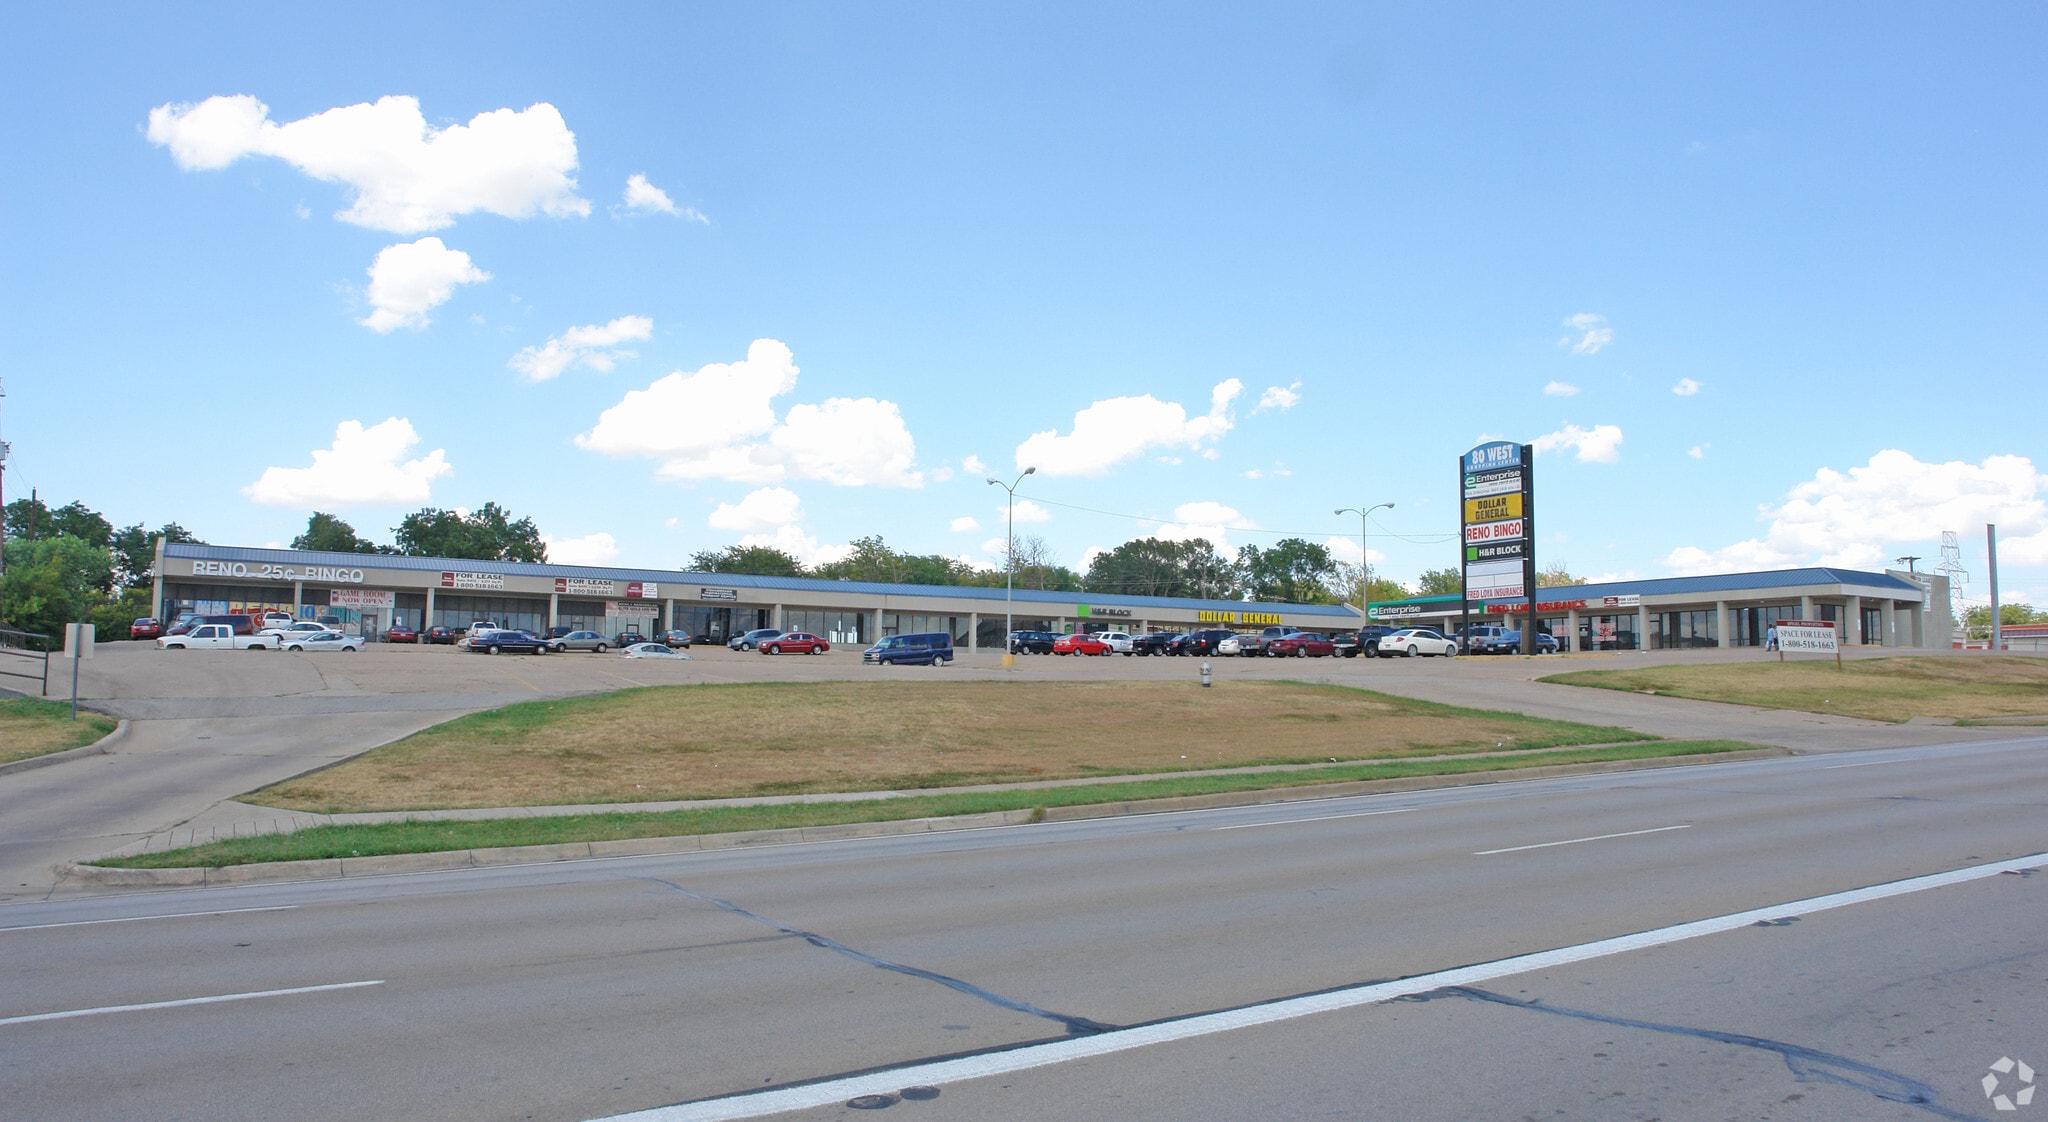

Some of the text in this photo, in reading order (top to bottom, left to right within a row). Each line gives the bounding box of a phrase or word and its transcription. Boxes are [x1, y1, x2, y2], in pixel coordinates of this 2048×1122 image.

[1472, 444, 1514, 465] 80 WEST
[1467, 457, 1519, 470] SHOPPING CENTER
[1476, 470, 1521, 482] Enterprise
[1477, 498, 1507, 510] DOLLAR
[1475, 507, 1509, 520] GENERAL
[1466, 522, 1521, 541] RENO BINGO
[1478, 545, 1521, 557] H&R BLOCK
[193, 560, 248, 578] RENO
[305, 567, 365, 583] BINGO
[340, 589, 386, 598] GAME ROOM
[1467, 586, 1523, 598] FRED LOYA INSURANCE
[1109, 608, 1132, 617] BLOCK
[1378, 604, 1421, 615] Enterprise
[1487, 600, 1587, 613] FRED LOY INSURANCE
[1199, 610, 1283, 625] DOLLAR GENERAL
[1780, 630, 1834, 639] SPACE FOR LEASE
[1781, 640, 1835, 650] 1-800-518-1663
